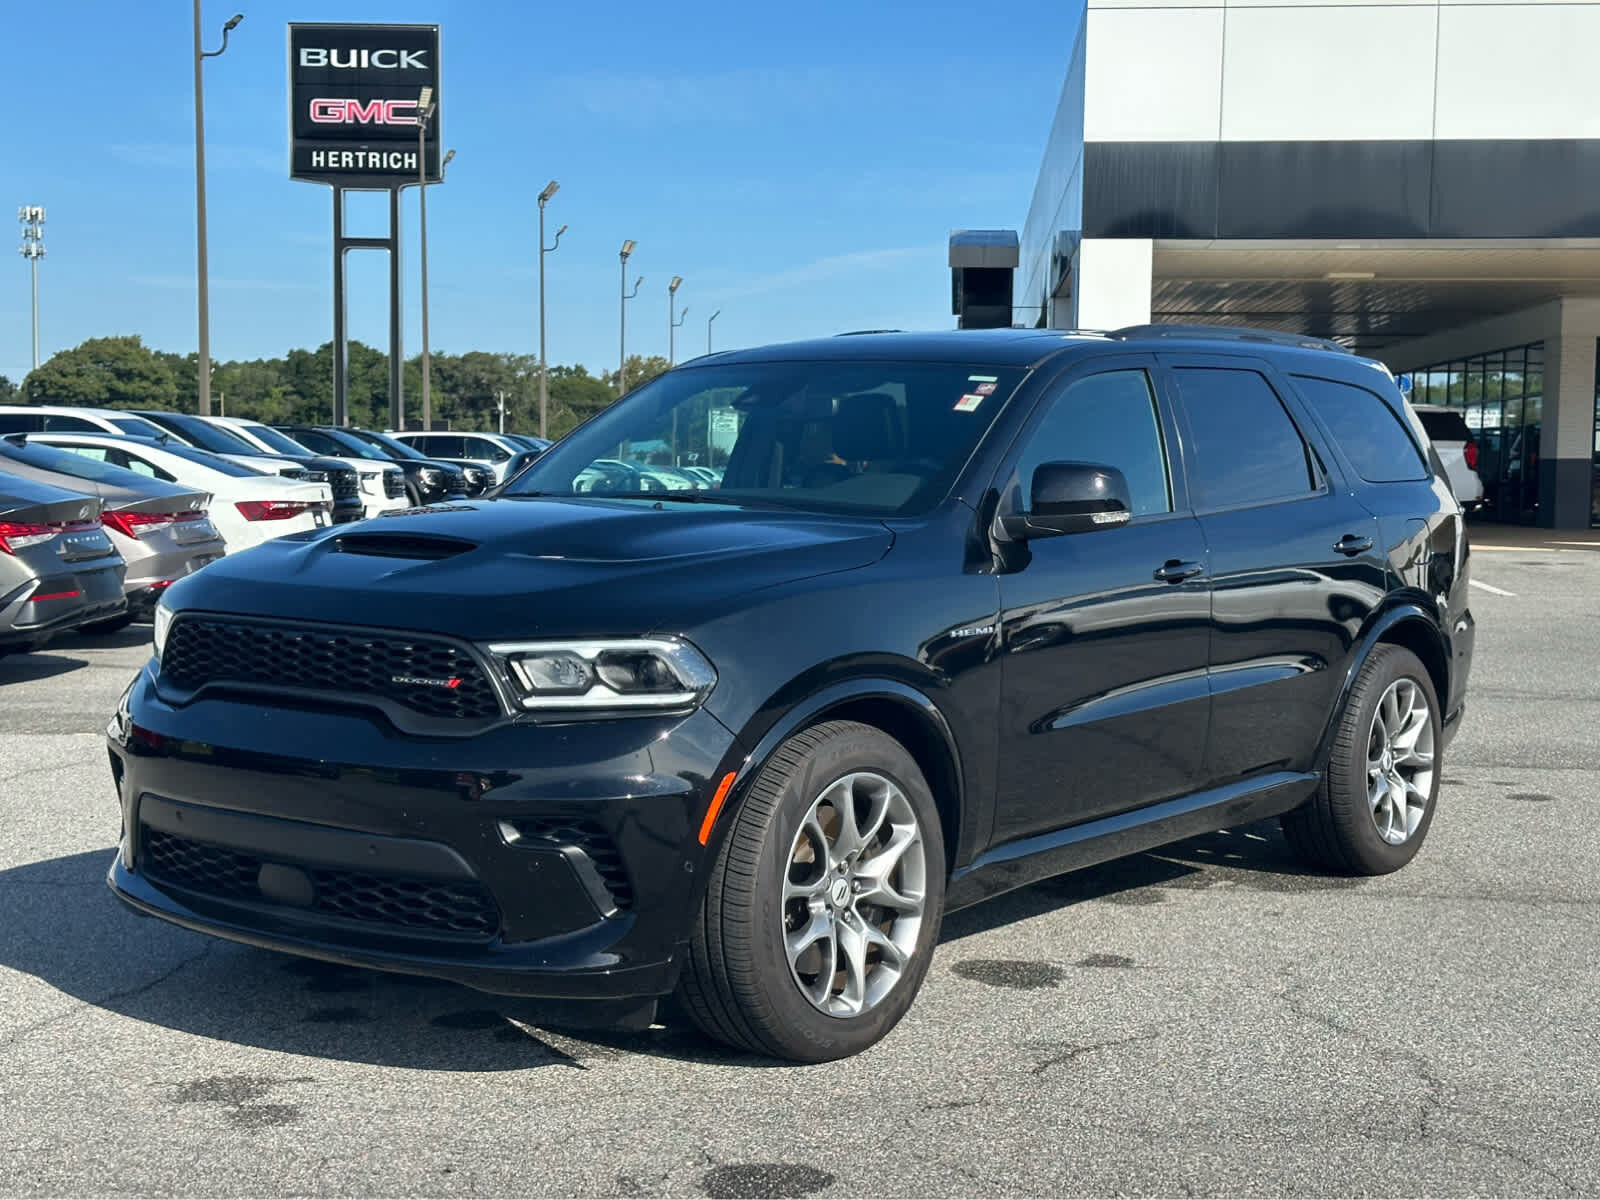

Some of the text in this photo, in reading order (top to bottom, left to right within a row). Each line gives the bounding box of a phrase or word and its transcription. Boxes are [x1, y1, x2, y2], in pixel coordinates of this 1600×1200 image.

[299, 47, 428, 69] BUICK
[309, 97, 418, 125] GMC
[311, 150, 417, 169] HERTRICH
[951, 626, 994, 638] HEMI
